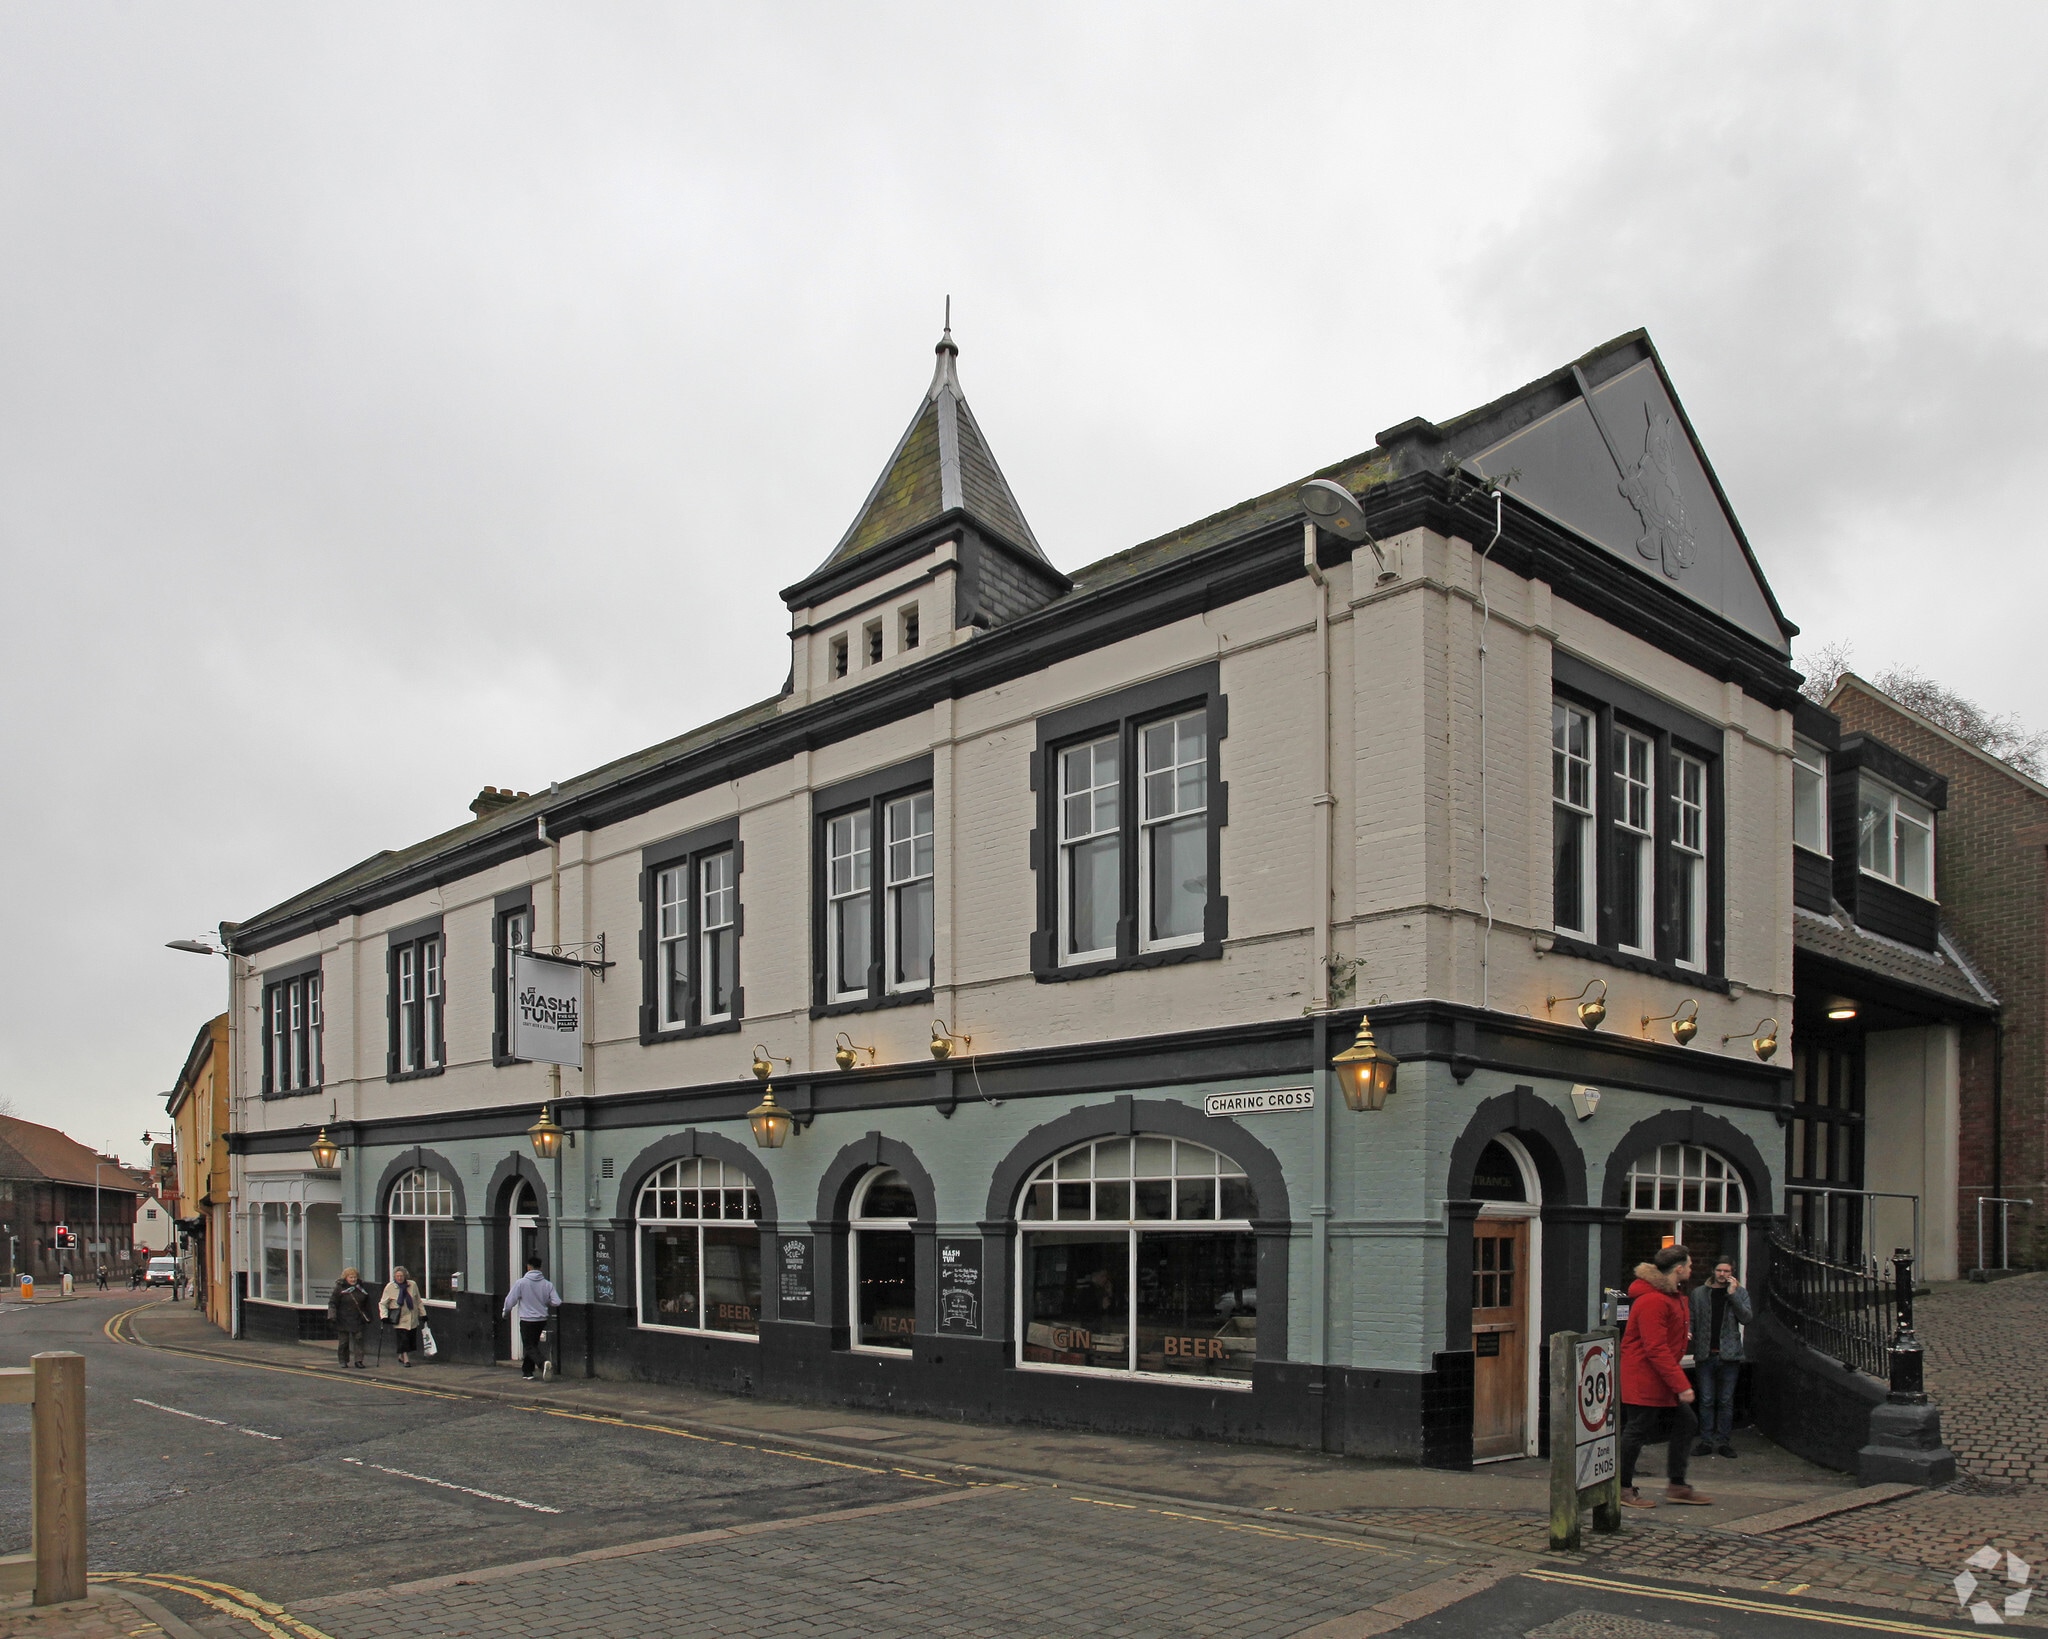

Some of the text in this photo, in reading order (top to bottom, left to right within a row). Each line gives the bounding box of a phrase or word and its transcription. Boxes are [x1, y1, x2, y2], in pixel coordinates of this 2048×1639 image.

[520, 992, 571, 1012] MASH
[521, 1006, 556, 1024] TUN
[1211, 1092, 1311, 1111] CHARING CROSS
[1473, 1175, 1512, 1187] TRANCE
[942, 1249, 960, 1257] MASH
[1164, 1336, 1230, 1360] BEER.
[1584, 1371, 1606, 1407] 30
[1597, 1446, 1610, 1458] Zone
[1594, 1458, 1613, 1477] ENDS
